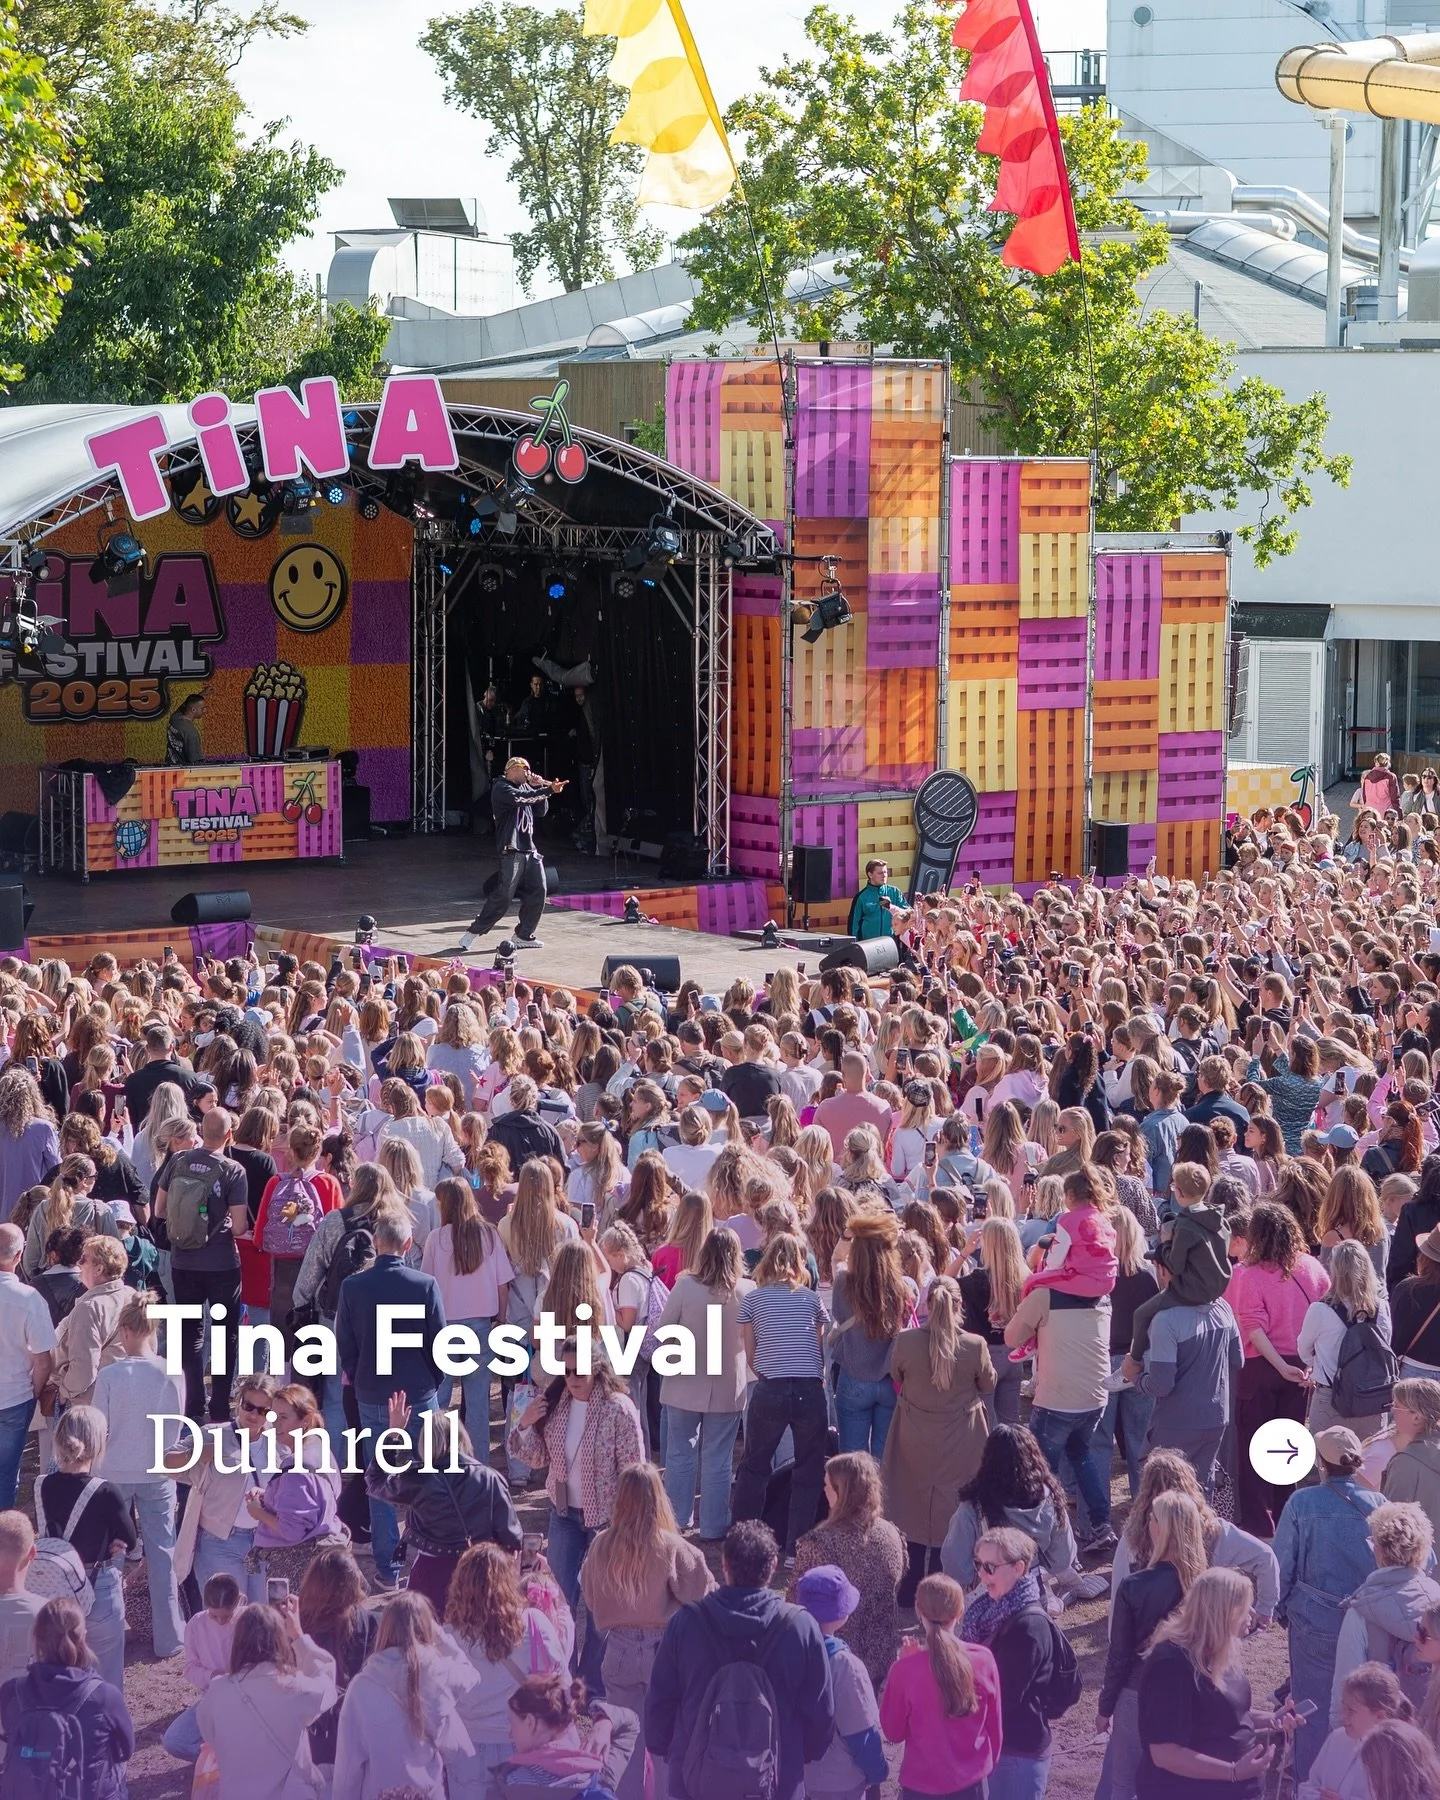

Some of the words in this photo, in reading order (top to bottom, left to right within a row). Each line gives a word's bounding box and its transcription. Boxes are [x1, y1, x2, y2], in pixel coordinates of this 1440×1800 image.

[30, 679, 161, 715] 2025
[181, 816, 252, 830] FESTIVAL
[194, 829, 238, 843] 2025
